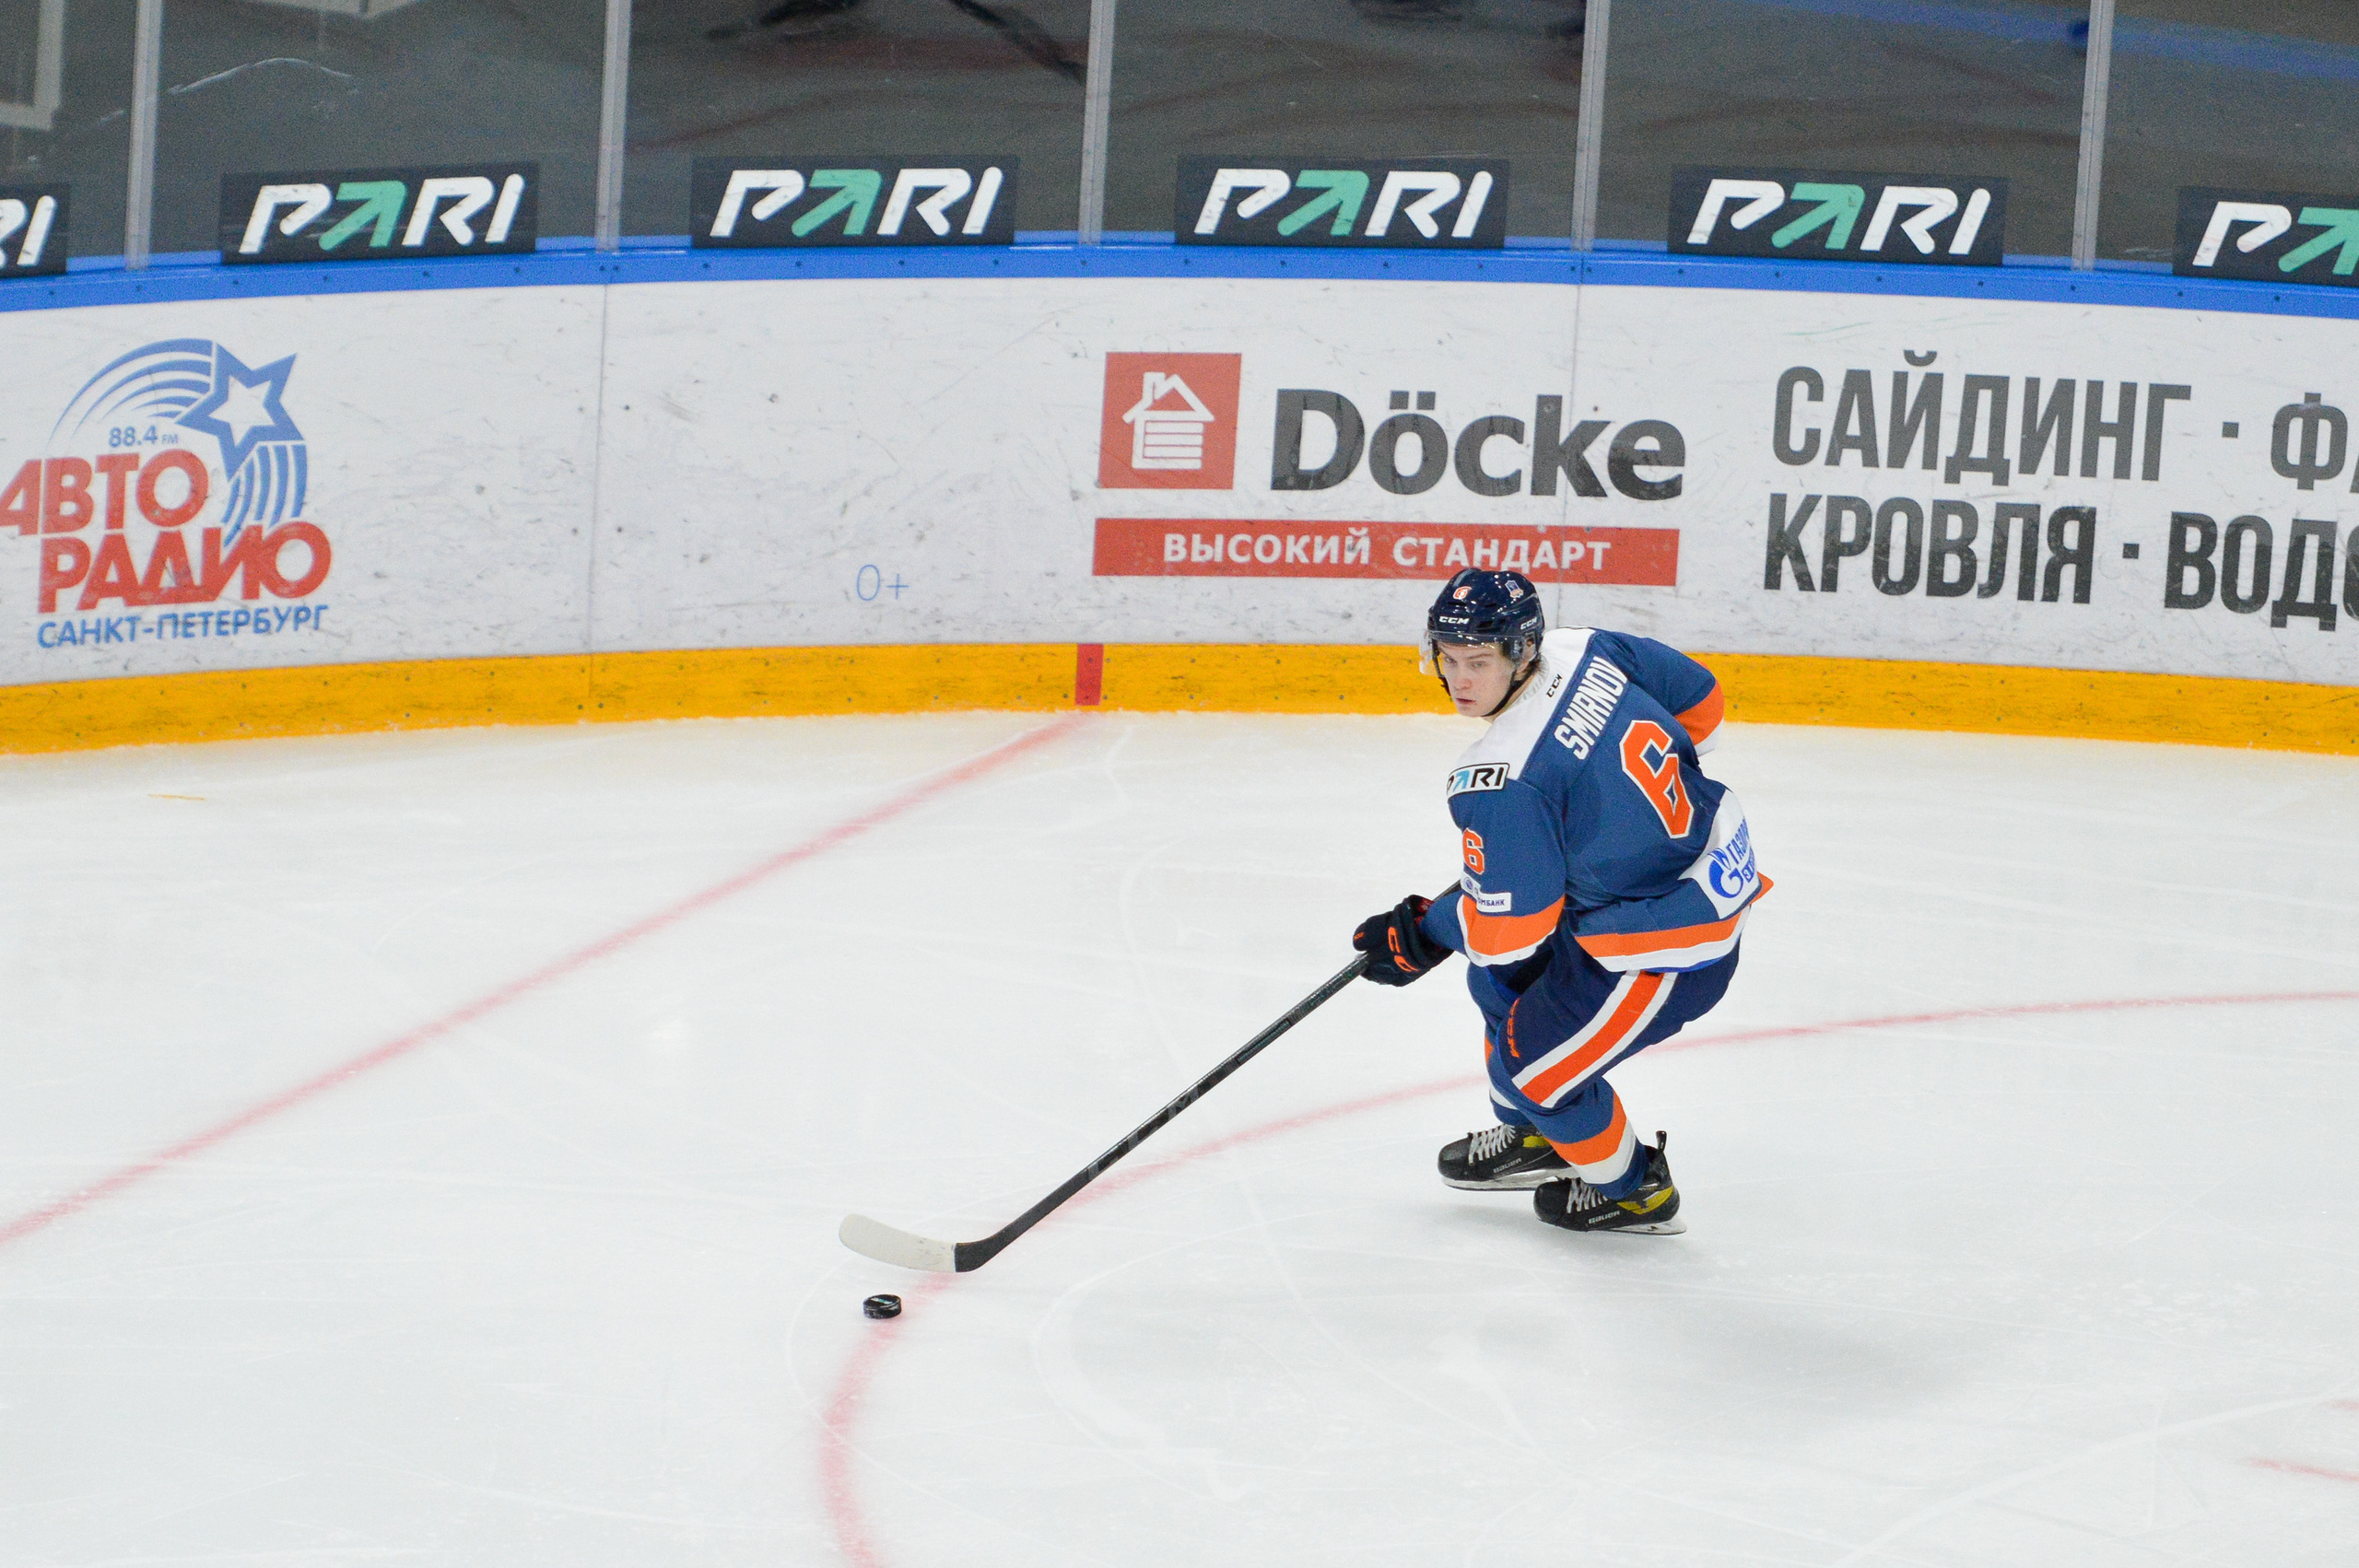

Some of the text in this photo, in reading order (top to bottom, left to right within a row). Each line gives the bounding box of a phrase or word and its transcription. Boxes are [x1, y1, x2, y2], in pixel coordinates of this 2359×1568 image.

[240, 173, 525, 254] PARI
[710, 167, 1003, 238] PARI
[1194, 169, 1493, 238] PARI
[1687, 180, 1991, 255] PARI
[109, 425, 179, 447] 88.4 FM
[1270, 388, 1686, 500] Döcke
[1772, 349, 2359, 493] САЙДИНГ Ф
[0, 449, 209, 535] АВТО
[38, 521, 333, 613] РАДИО
[856, 564, 910, 601] 0+
[1163, 528, 1611, 574] ВЫСОКИЙ СТАНДАРТ
[1764, 492, 2097, 604] КРОВЛЯ
[37, 604, 328, 648] САНКТ-ПЕТЕРБУРГ
[1438, 615, 1470, 625] CCM
[1520, 616, 1538, 630] CCM
[1546, 673, 1563, 697] CCM
[1554, 656, 1628, 760] SMIRNOV
[1619, 720, 1694, 838] 6
[1462, 827, 1485, 875] 6
